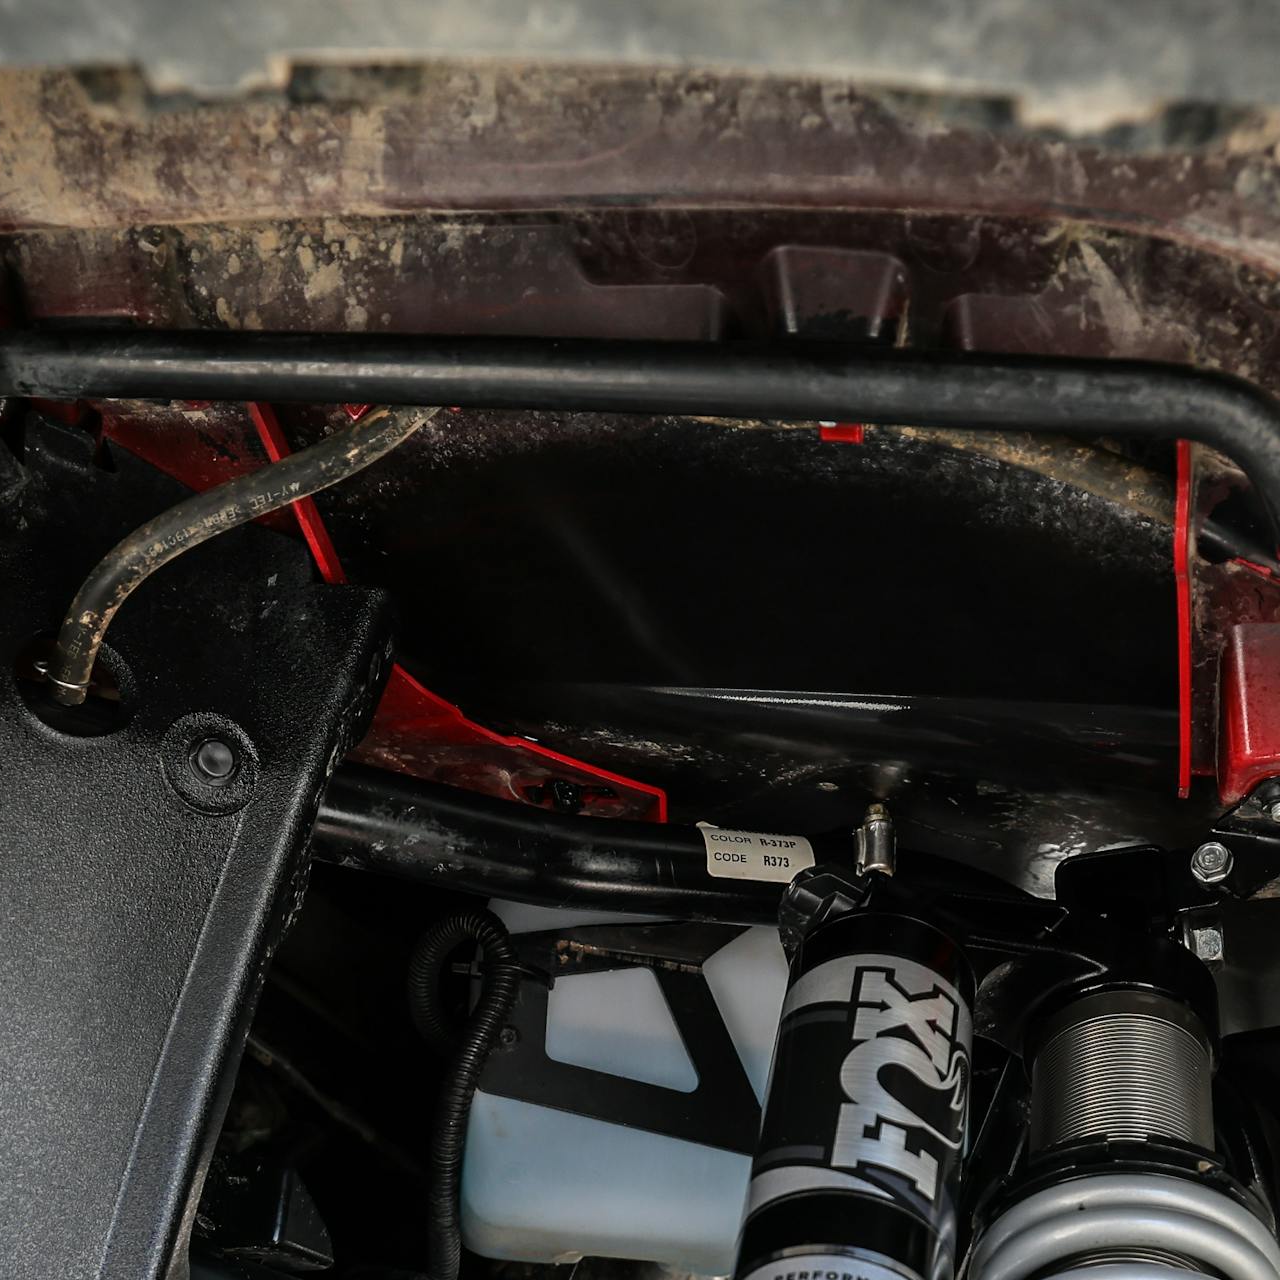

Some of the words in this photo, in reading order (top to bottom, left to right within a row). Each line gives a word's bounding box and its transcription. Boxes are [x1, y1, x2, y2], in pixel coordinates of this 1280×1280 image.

[710, 834, 752, 844] COLOR
[760, 838, 796, 849] R-373P
[714, 852, 747, 863] CODE
[764, 855, 790, 868] R373
[831, 970, 969, 1200] FOX
